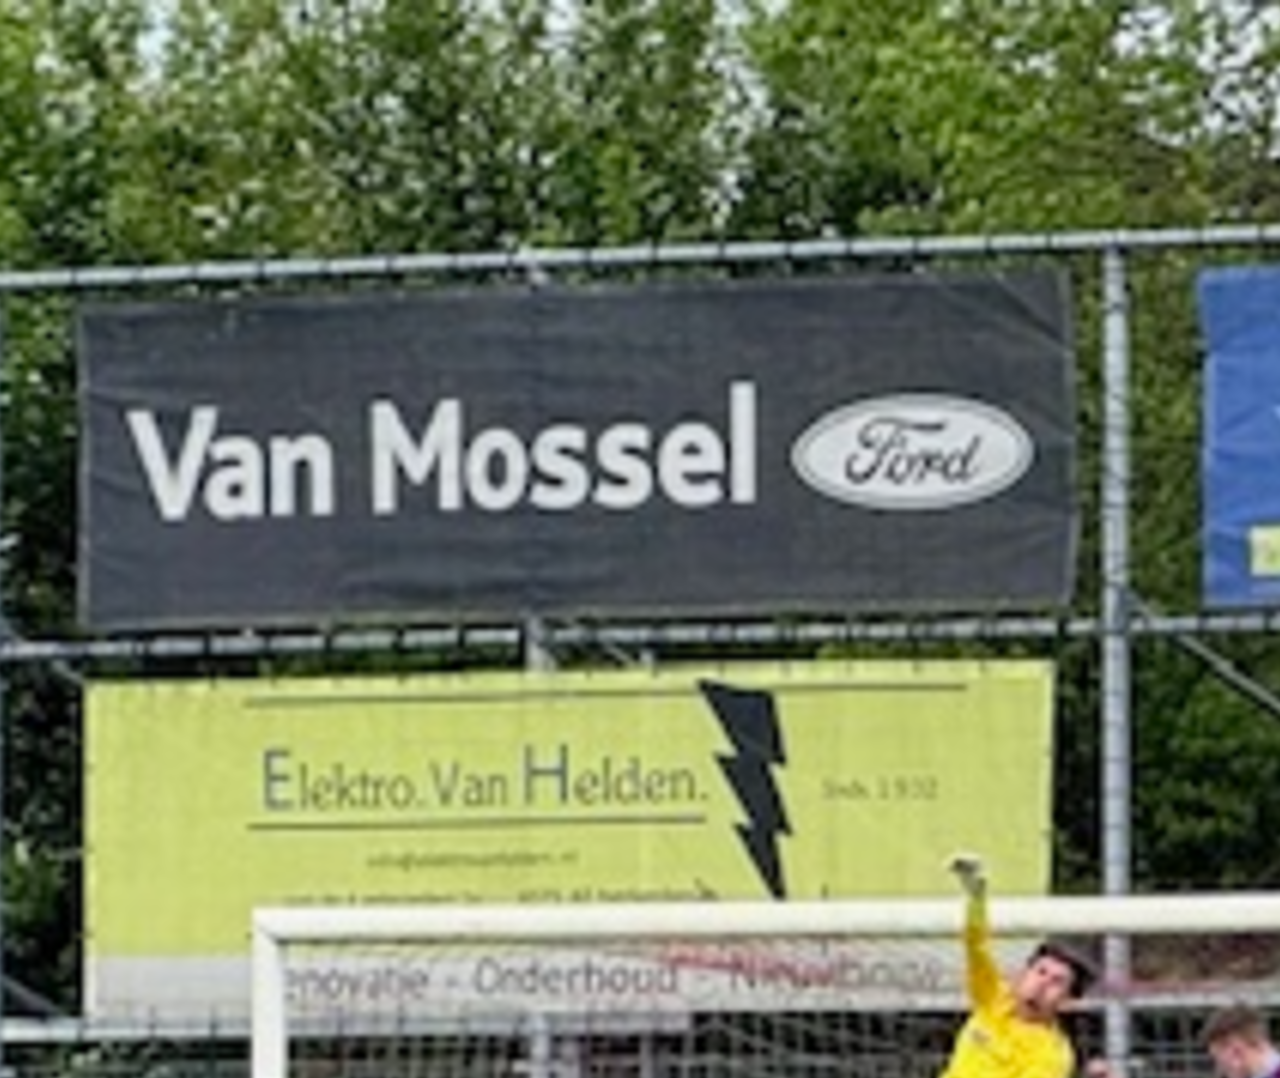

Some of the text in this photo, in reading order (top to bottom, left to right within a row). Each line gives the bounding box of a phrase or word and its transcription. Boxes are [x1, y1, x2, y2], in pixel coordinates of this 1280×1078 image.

[129, 381, 757, 520] Van Mossel
[842, 417, 981, 486] Ford
[430, 761, 507, 807] Van
[524, 744, 709, 805] Helden.
[474, 957, 677, 995] Onderhoud
